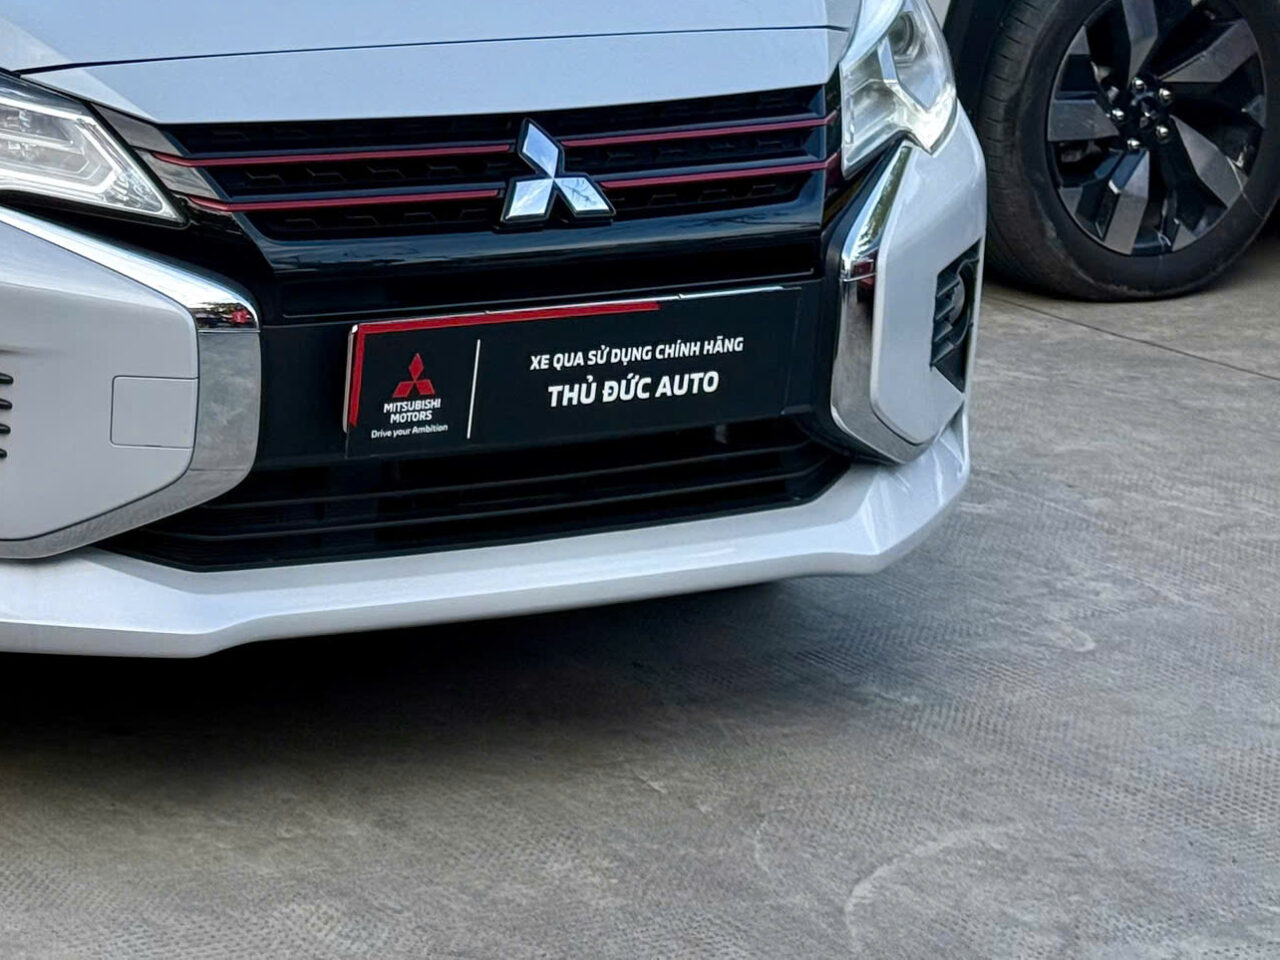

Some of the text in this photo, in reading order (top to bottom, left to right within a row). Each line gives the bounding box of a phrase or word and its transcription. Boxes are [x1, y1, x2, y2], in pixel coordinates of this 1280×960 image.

[529, 336, 744, 371] XE QUA SỬ DỤNG CHÍNH HÃNG
[548, 370, 719, 408] THỦ ĐỨC AUTO
[383, 398, 442, 414] MITSUBISHI
[390, 410, 433, 424] MOTORS
[371, 423, 449, 439] Drive your Ambition
